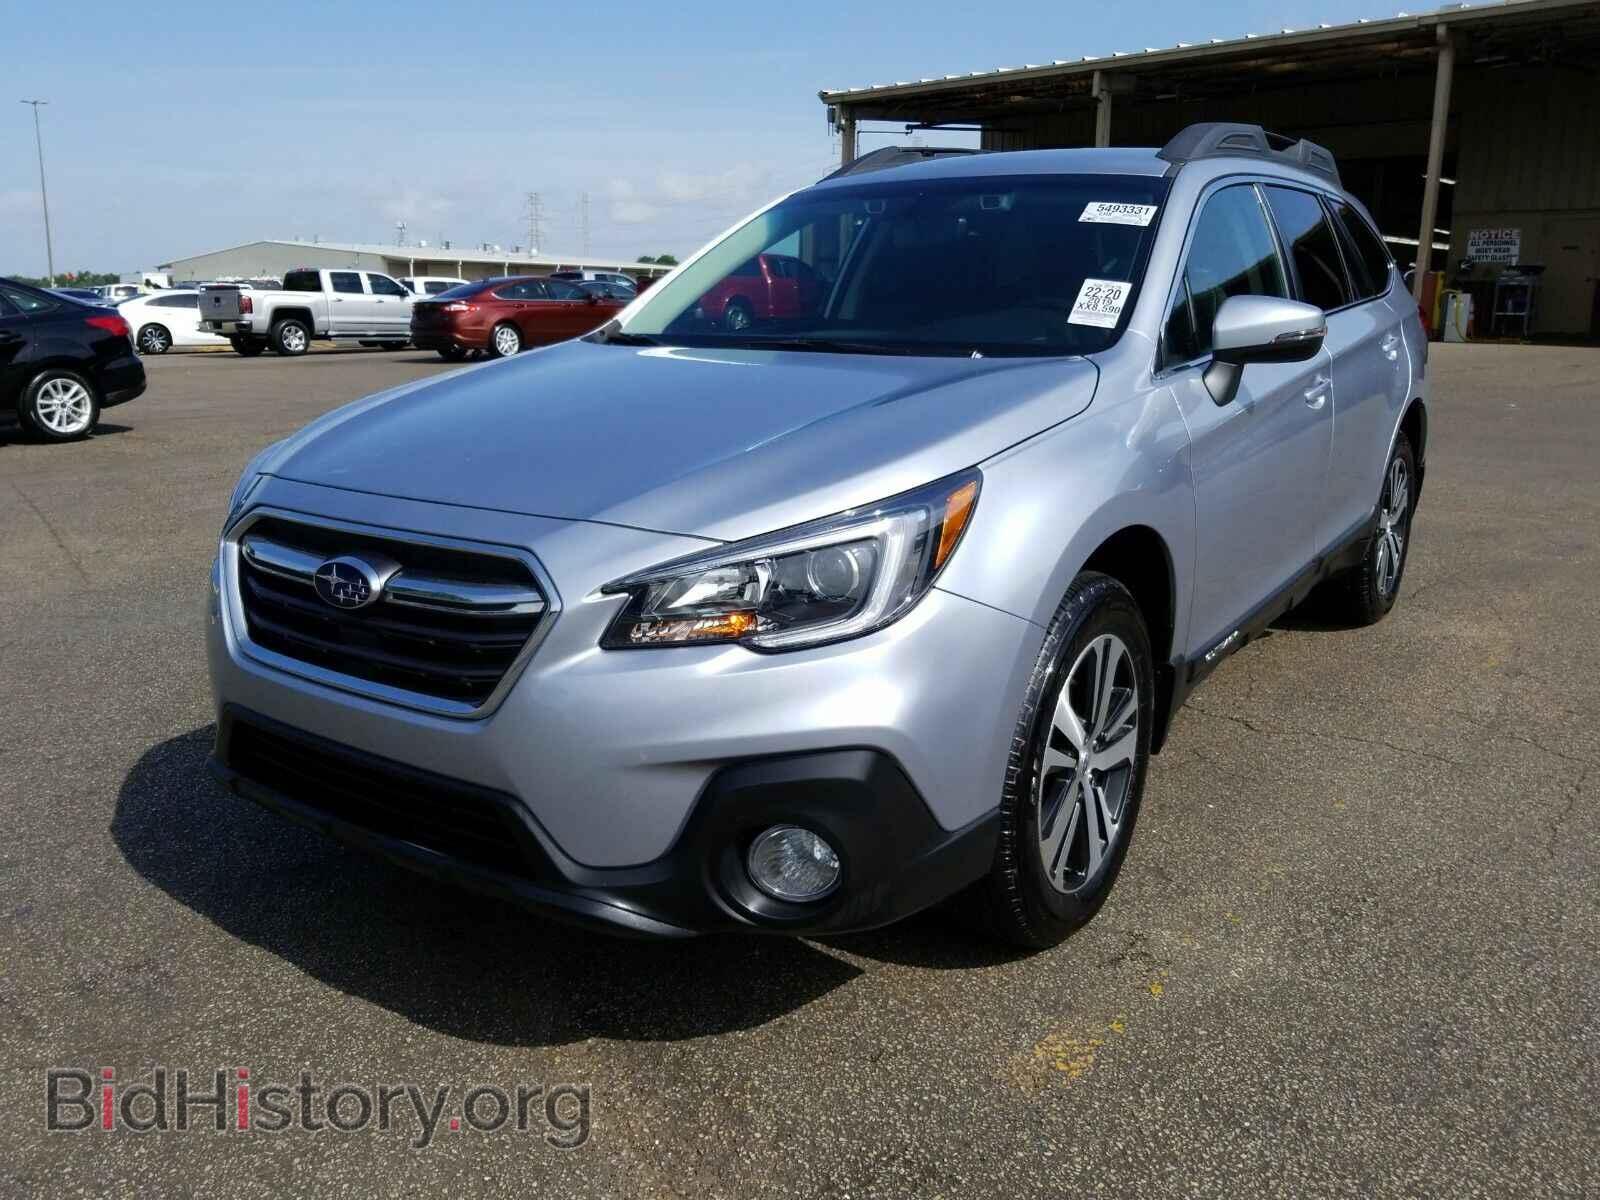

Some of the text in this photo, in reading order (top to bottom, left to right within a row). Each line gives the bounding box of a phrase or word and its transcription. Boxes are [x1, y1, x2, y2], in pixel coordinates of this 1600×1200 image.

[1096, 203, 1150, 215] 5493331
[1470, 229, 1521, 240] NOTICE
[1084, 286, 1122, 300] 22:20
[1088, 297, 1113, 305] 2019
